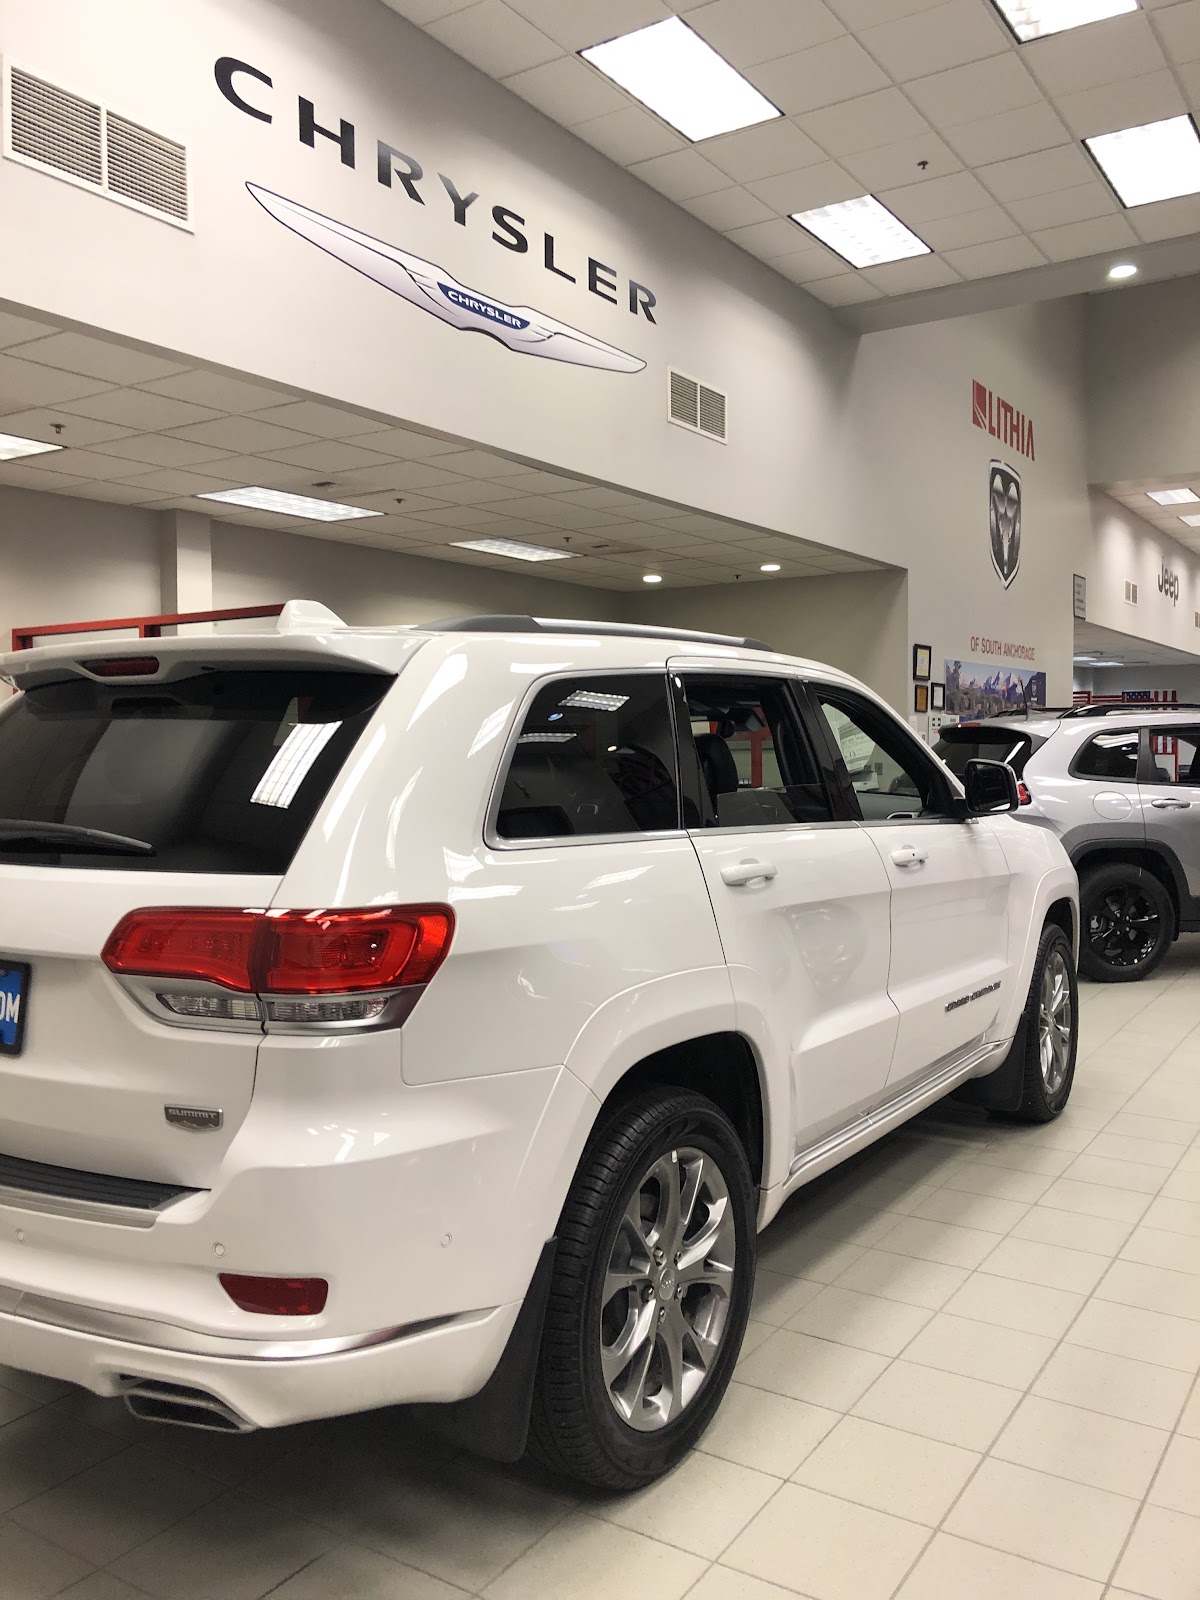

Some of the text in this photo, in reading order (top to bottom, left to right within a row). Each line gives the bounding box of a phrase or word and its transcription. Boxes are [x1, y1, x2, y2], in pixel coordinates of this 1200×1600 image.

[214, 56, 658, 325] CHRYSLER
[447, 290, 522, 328] CHRYSLER
[988, 390, 1035, 461] LITHIA
[1157, 556, 1179, 607] Jeep
[970, 635, 980, 652] OF
[981, 637, 1002, 656] SOUTH
[168, 1108, 217, 1119] SUMMIT
